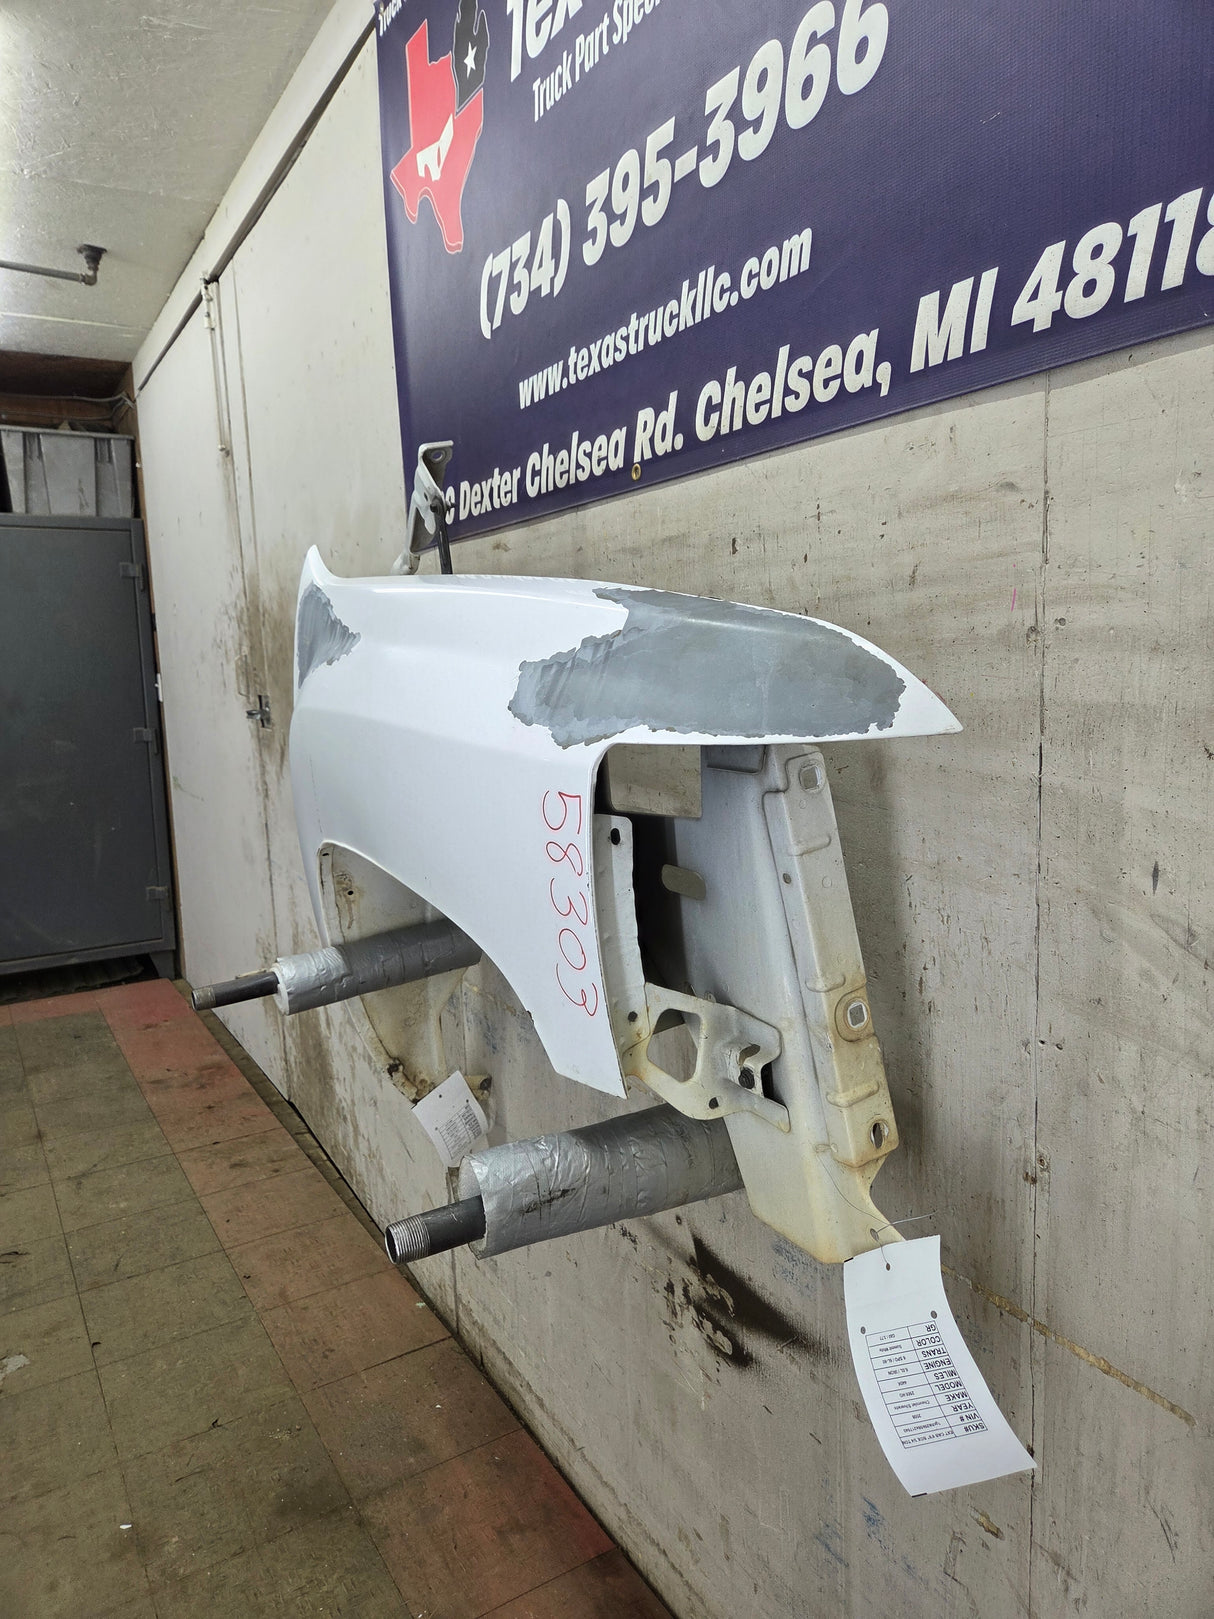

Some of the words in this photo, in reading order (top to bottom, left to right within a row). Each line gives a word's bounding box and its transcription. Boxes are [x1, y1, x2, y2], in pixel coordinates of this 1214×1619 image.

[532, 50, 572, 123] Truck
[575, 12, 610, 83] Part
[480, 198, 570, 339] (734)
[582, 0, 889, 266] 395-3966
[518, 227, 812, 409] www.texastruckllc.com
[459, 464, 521, 521] Dexter
[525, 424, 627, 499] Chelsea
[633, 390, 684, 463] Rd.
[695, 328, 892, 442] Chelsea,
[910, 266, 999, 373] MI
[542, 790, 598, 1017] 58303
[925, 1323, 936, 1332] GR
[916, 1335, 941, 1347] COLOR
[922, 1347, 946, 1358] TRANS
[924, 1358, 951, 1370] ENGINE
[934, 1369, 957, 1380] MILES
[935, 1380, 962, 1392] MODEL
[945, 1391, 968, 1402] MAKE
[951, 1402, 974, 1412] YEAR
[966, 1412, 980, 1421] VIN
[963, 1422, 985, 1433] SKU#
